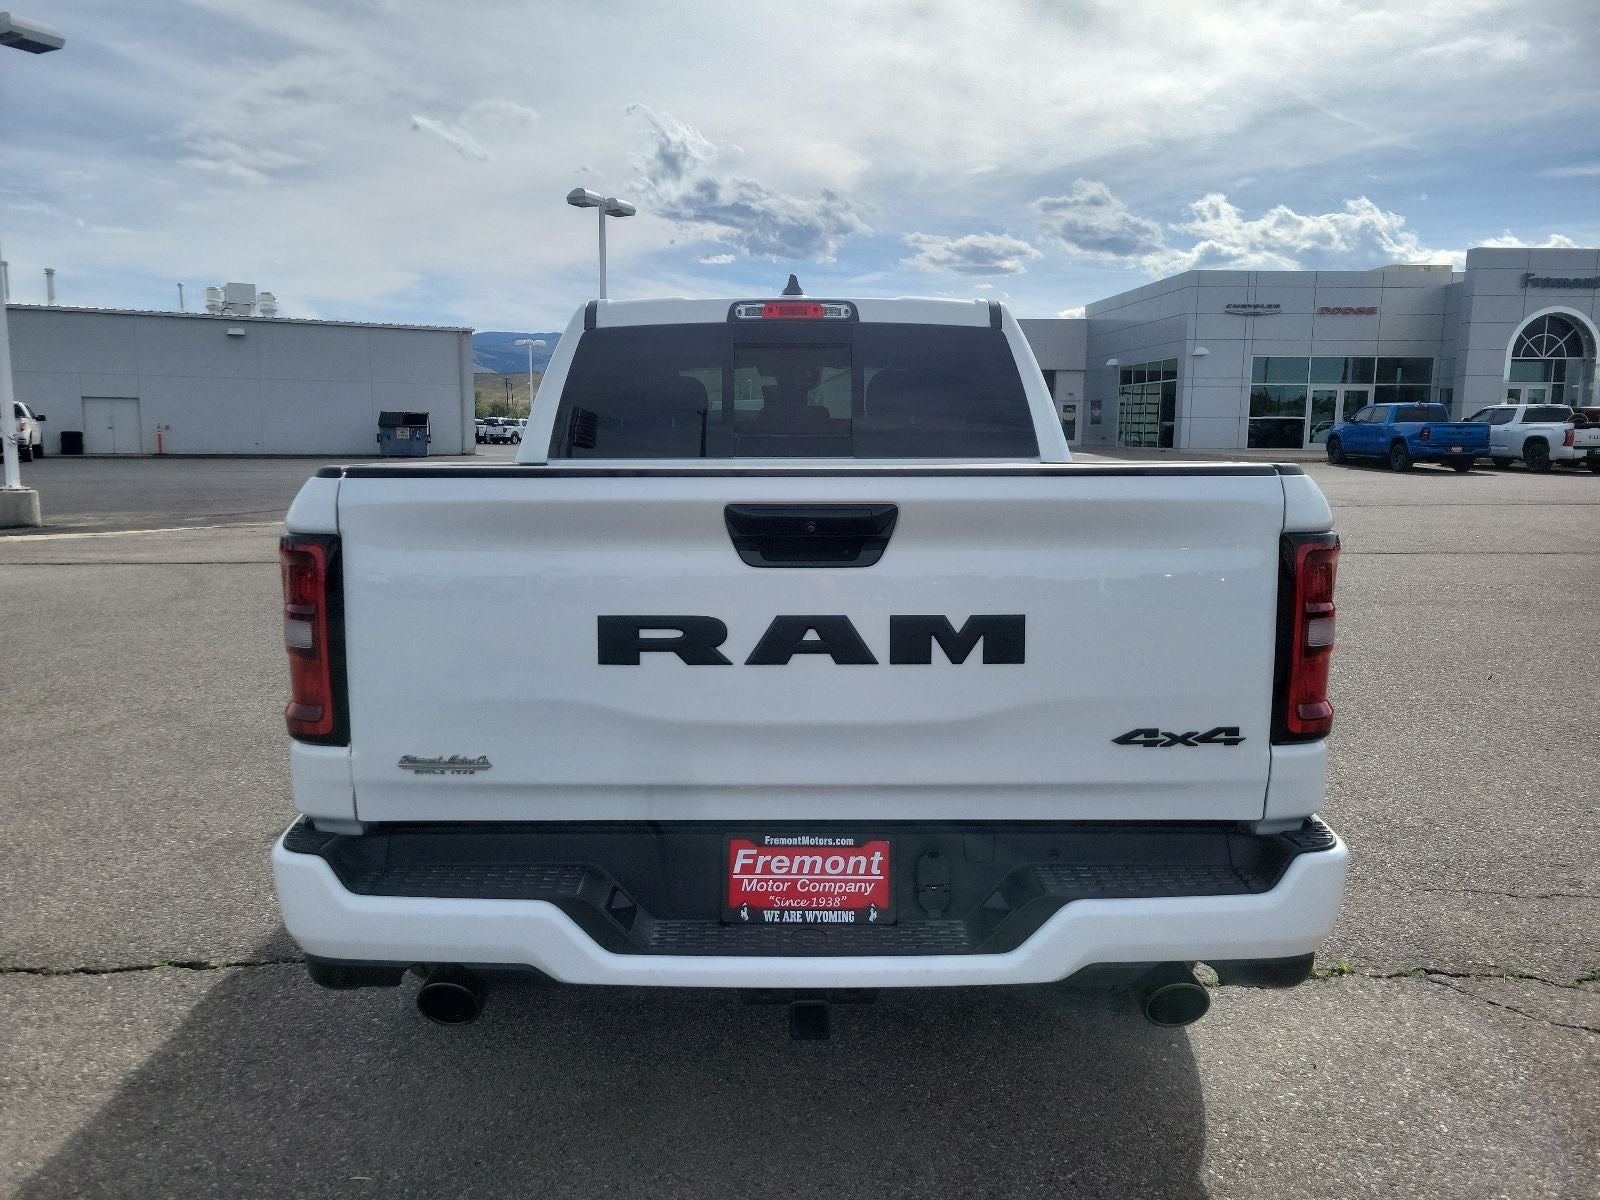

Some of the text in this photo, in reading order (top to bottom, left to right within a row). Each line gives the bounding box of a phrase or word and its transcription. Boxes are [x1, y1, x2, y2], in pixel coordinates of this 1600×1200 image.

[1319, 306, 1378, 315] DODGE
[597, 614, 1026, 666] RAM
[1110, 726, 1247, 748] 4x4
[764, 835, 854, 846] FremontMotors.com
[733, 849, 884, 875] Fremont
[741, 878, 876, 896] Motor Company
[764, 911, 855, 924] WE ARE WYOMING
